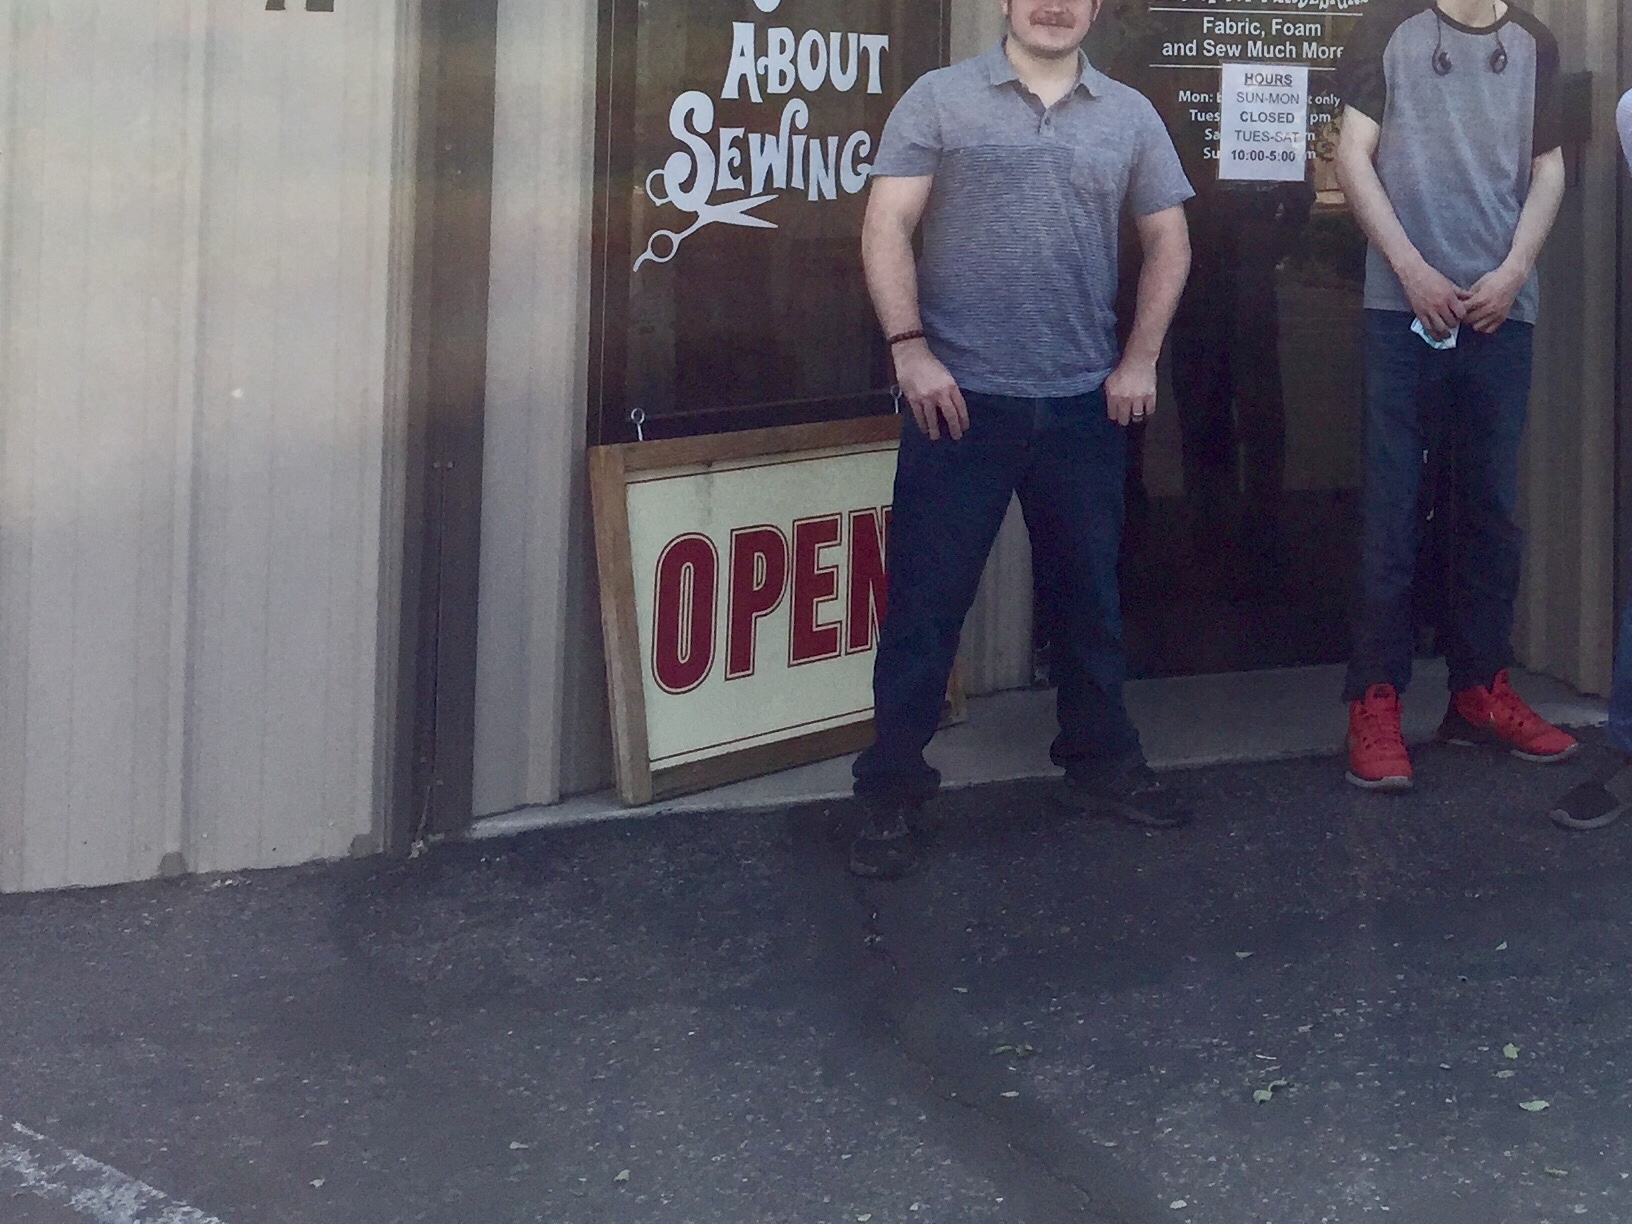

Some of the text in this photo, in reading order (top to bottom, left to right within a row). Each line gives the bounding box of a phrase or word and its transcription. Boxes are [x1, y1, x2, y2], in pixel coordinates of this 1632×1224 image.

[1203, 16, 1322, 38] Fabric, Foam
[1162, 39, 1197, 57] and
[1203, 39, 1242, 58] Sew
[1248, 40, 1296, 58] Much
[721, 21, 890, 104] ABOUT
[1244, 72, 1293, 86] HOURS
[1178, 90, 1214, 103] Mon:
[1236, 91, 1300, 104] SUN-MON
[1314, 94, 1341, 108] only
[1239, 111, 1295, 124] CLOSED
[1204, 128, 1220, 141] Sa
[1234, 129, 1300, 143] TUES-SAT
[664, 90, 873, 213] SEWING
[1203, 147, 1220, 160] Su
[1231, 149, 1296, 162] 10:00-5:00
